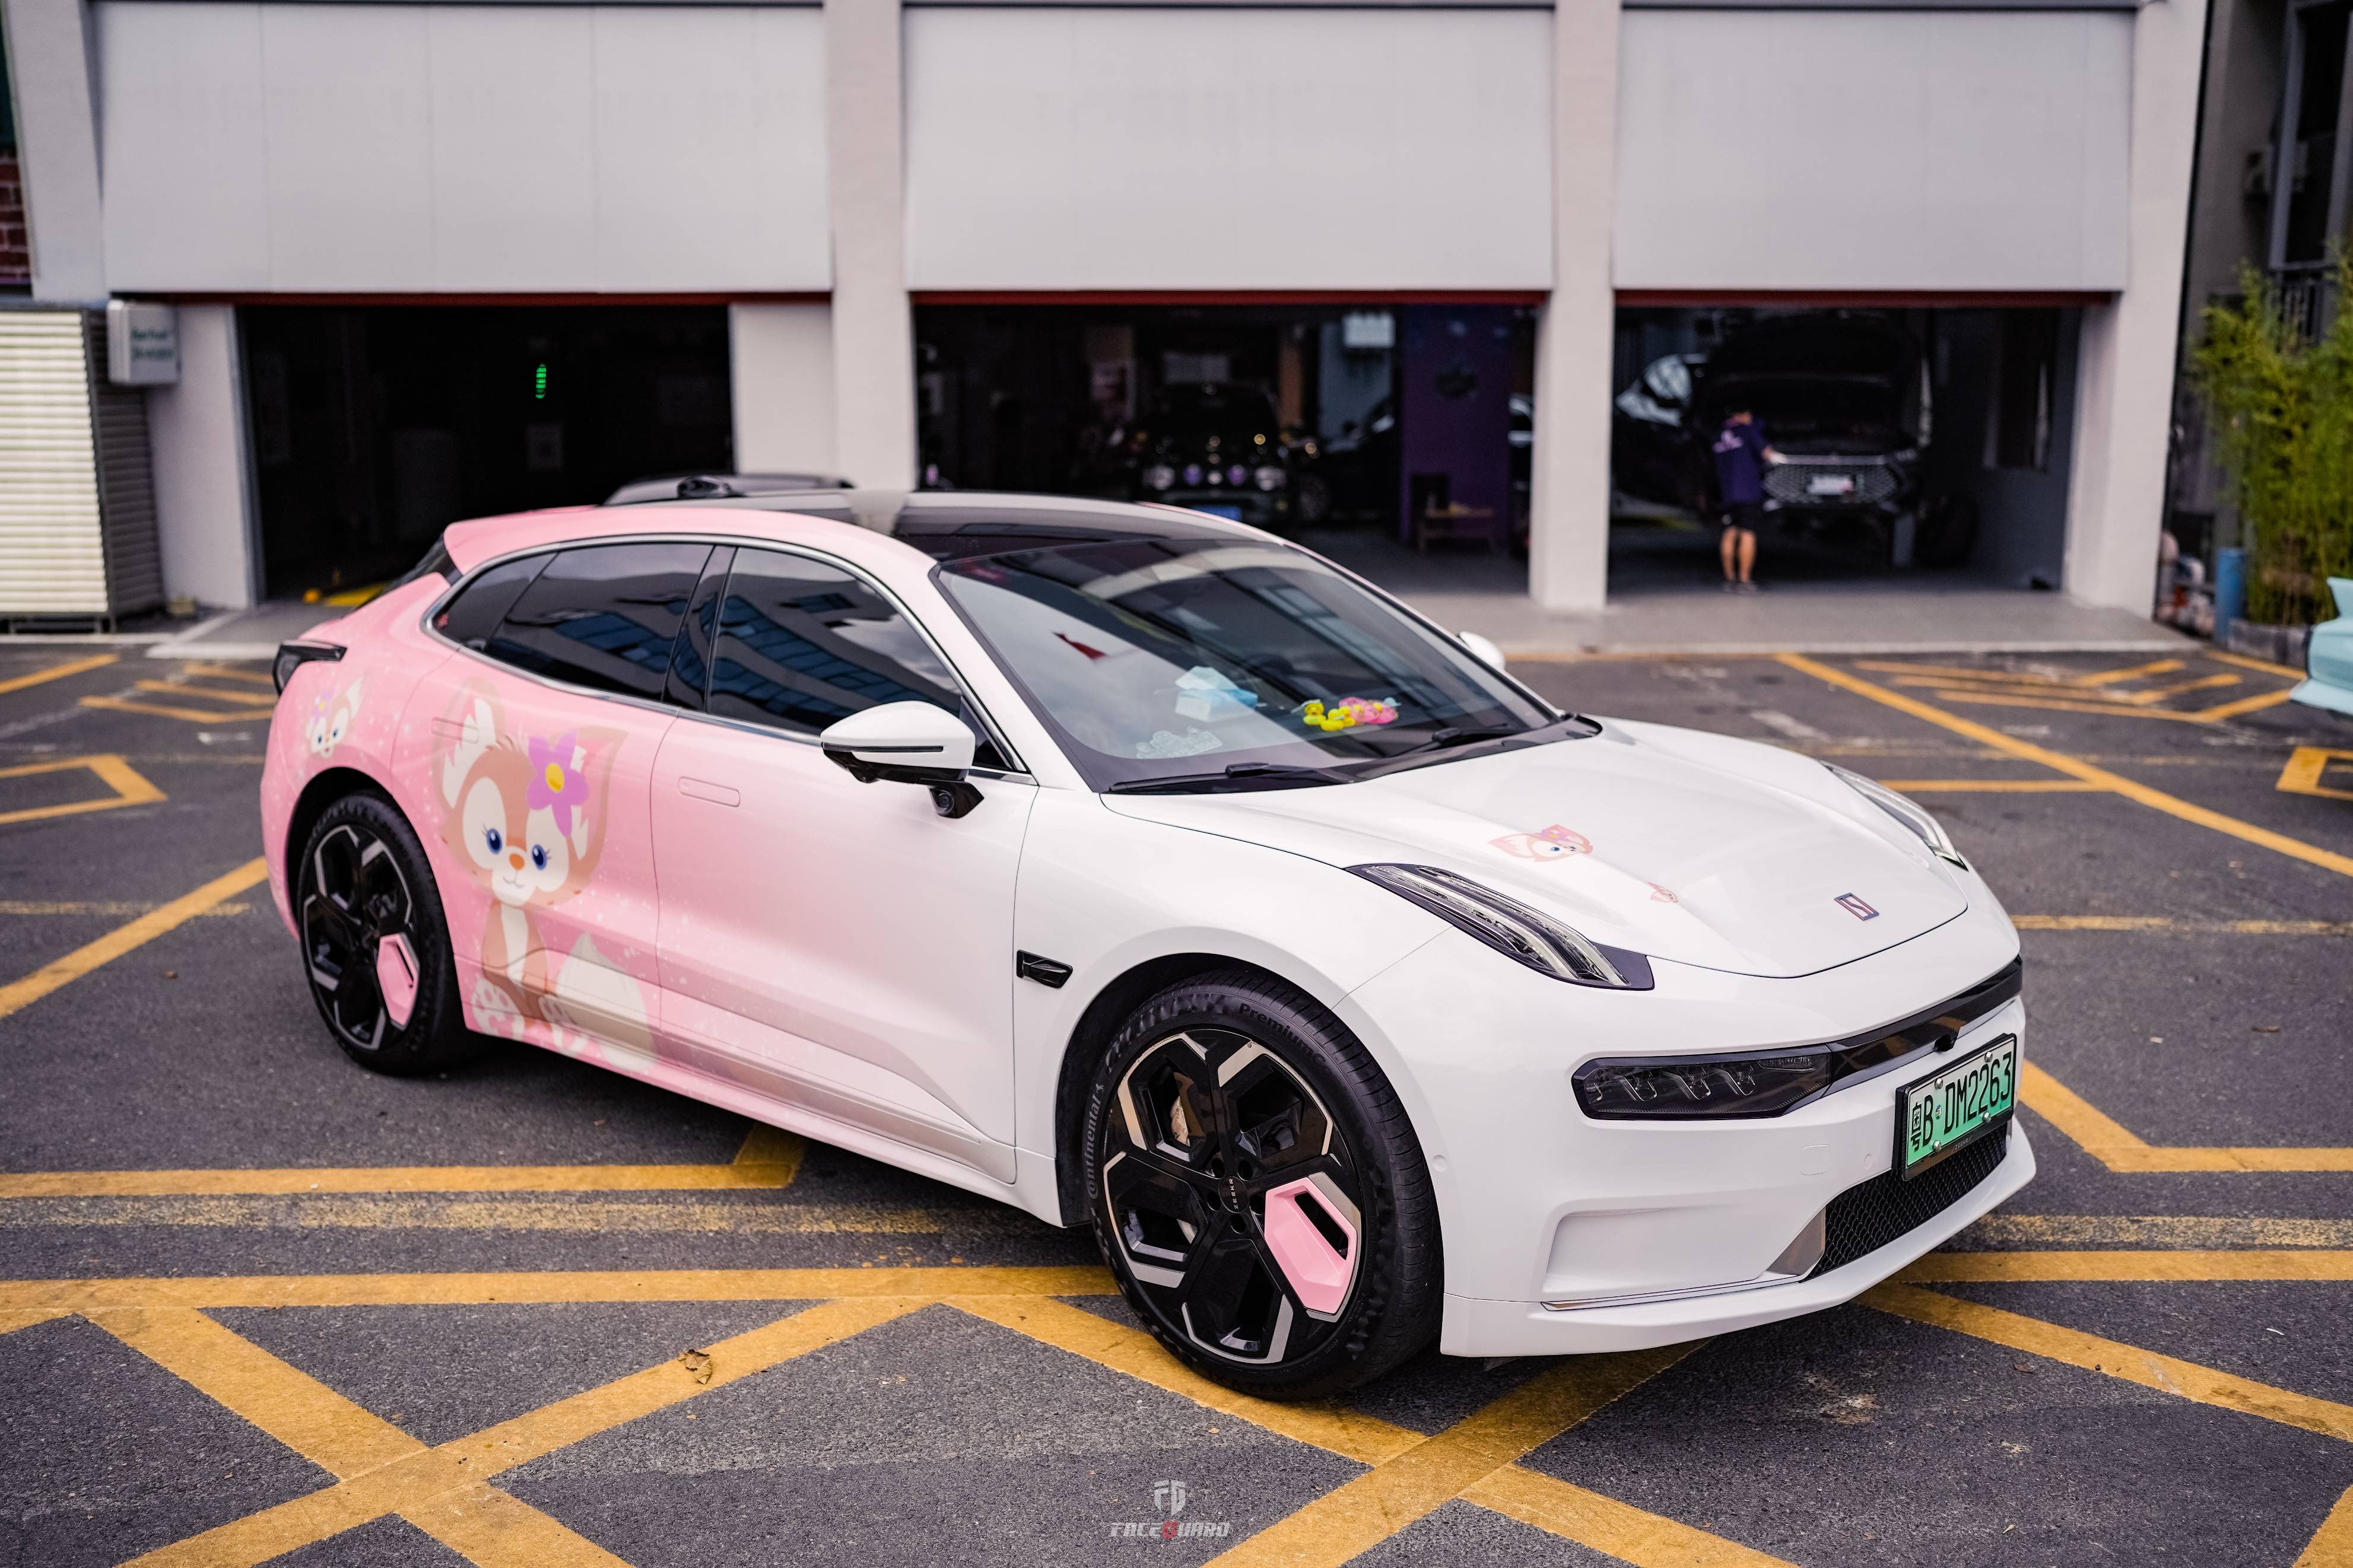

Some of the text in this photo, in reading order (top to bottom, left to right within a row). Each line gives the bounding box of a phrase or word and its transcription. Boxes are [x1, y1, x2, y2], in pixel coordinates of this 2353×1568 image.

[1944, 1051, 2012, 1135] DM2263
[1085, 1093, 1101, 1200] Continental
[1228, 1178, 1239, 1209] ZEEKR
